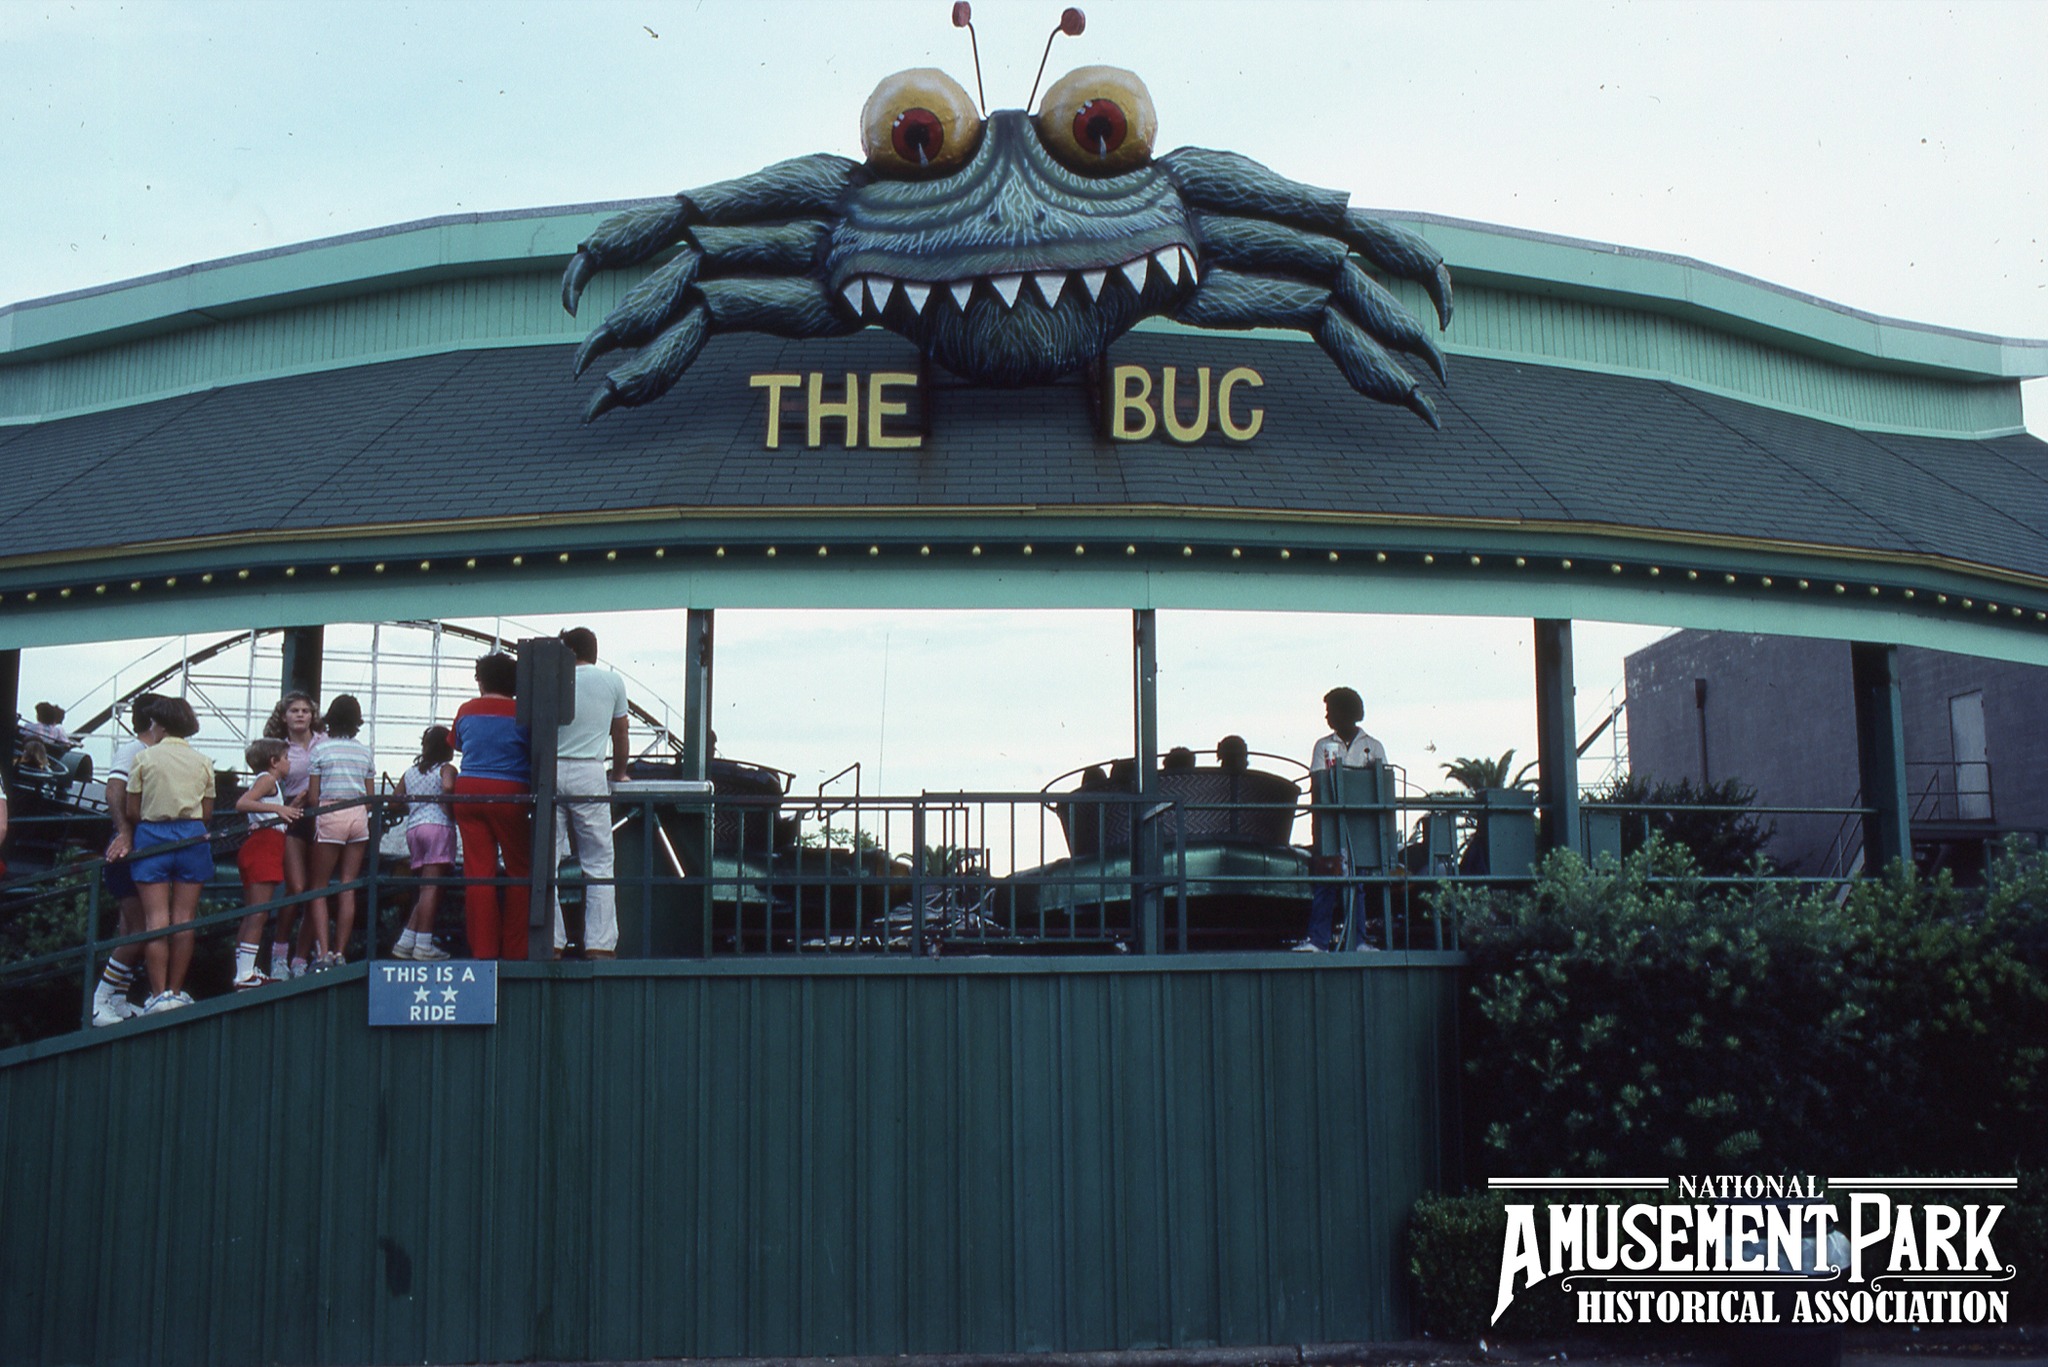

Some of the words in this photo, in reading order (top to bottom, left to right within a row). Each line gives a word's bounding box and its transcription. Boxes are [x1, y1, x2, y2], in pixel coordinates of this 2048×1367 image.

[749, 372, 922, 449] THE
[382, 966, 428, 983] THIS
[436, 966, 454, 982] IS
[461, 966, 476, 983] A
[410, 1005, 456, 1021] RIDE
